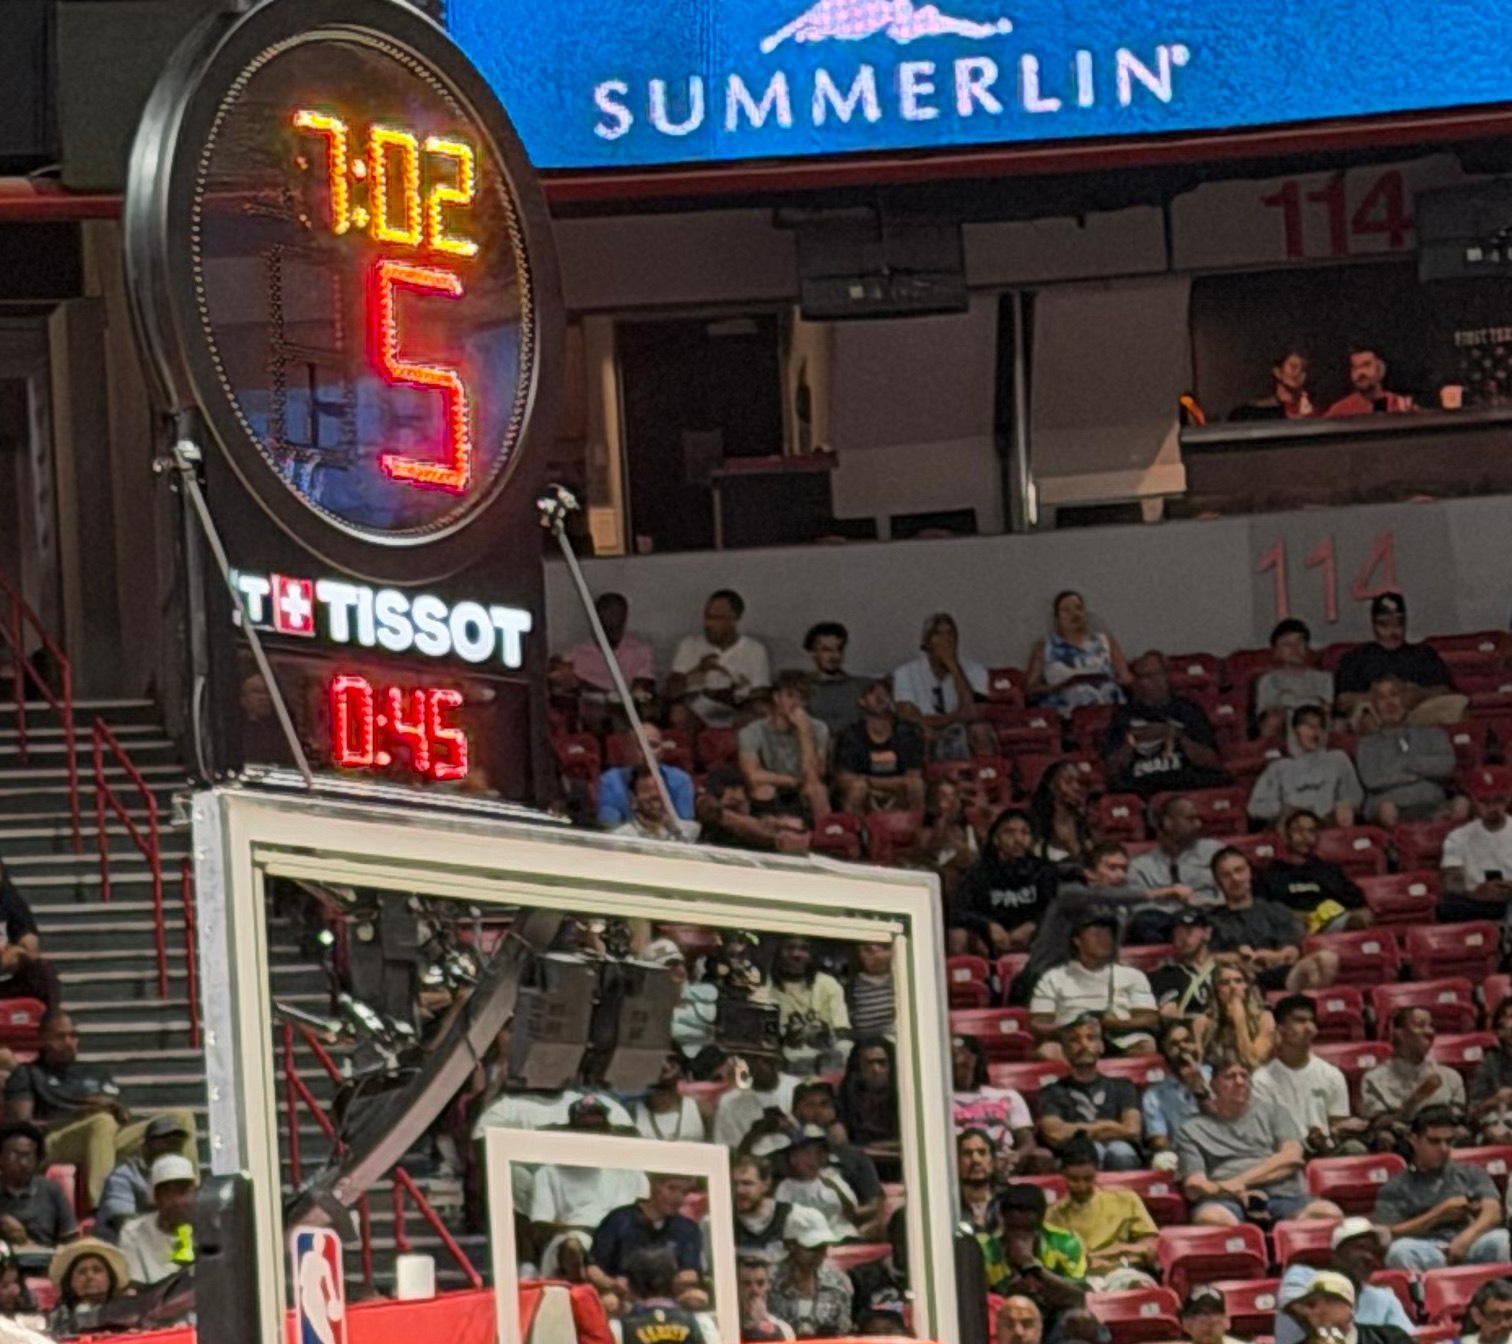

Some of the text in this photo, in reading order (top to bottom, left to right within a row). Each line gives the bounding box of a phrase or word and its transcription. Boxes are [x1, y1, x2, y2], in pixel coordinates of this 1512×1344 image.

[294, 110, 478, 257] 7:02
[1257, 170, 1414, 258] 114
[371, 258, 470, 494] 5
[316, 579, 532, 668] TISSOT
[1256, 530, 1406, 623] 114
[331, 674, 469, 781] 0:45
